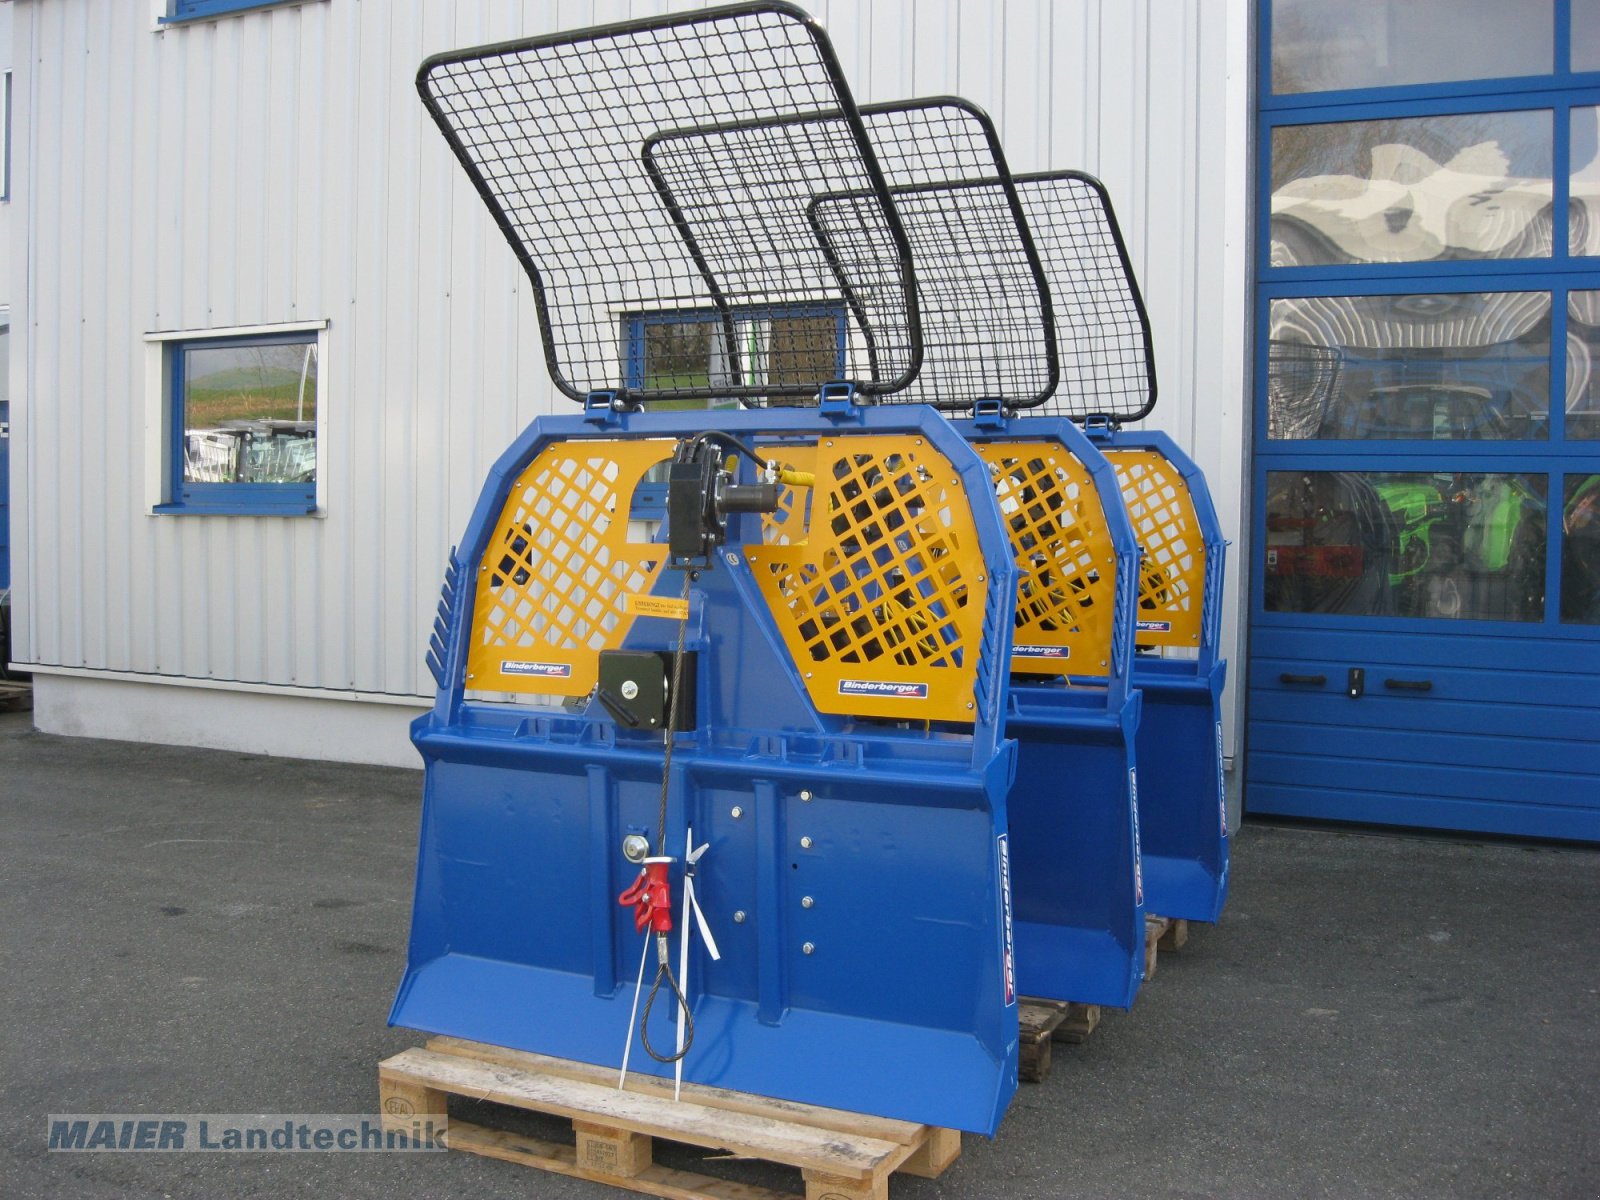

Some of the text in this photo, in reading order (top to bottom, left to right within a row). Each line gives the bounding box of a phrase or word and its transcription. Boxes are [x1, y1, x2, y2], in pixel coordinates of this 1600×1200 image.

[1012, 646, 1062, 654] derberger
[504, 662, 564, 672] Binderberger
[843, 681, 919, 693] Binderberger
[1001, 839, 1014, 995] Binderberger
